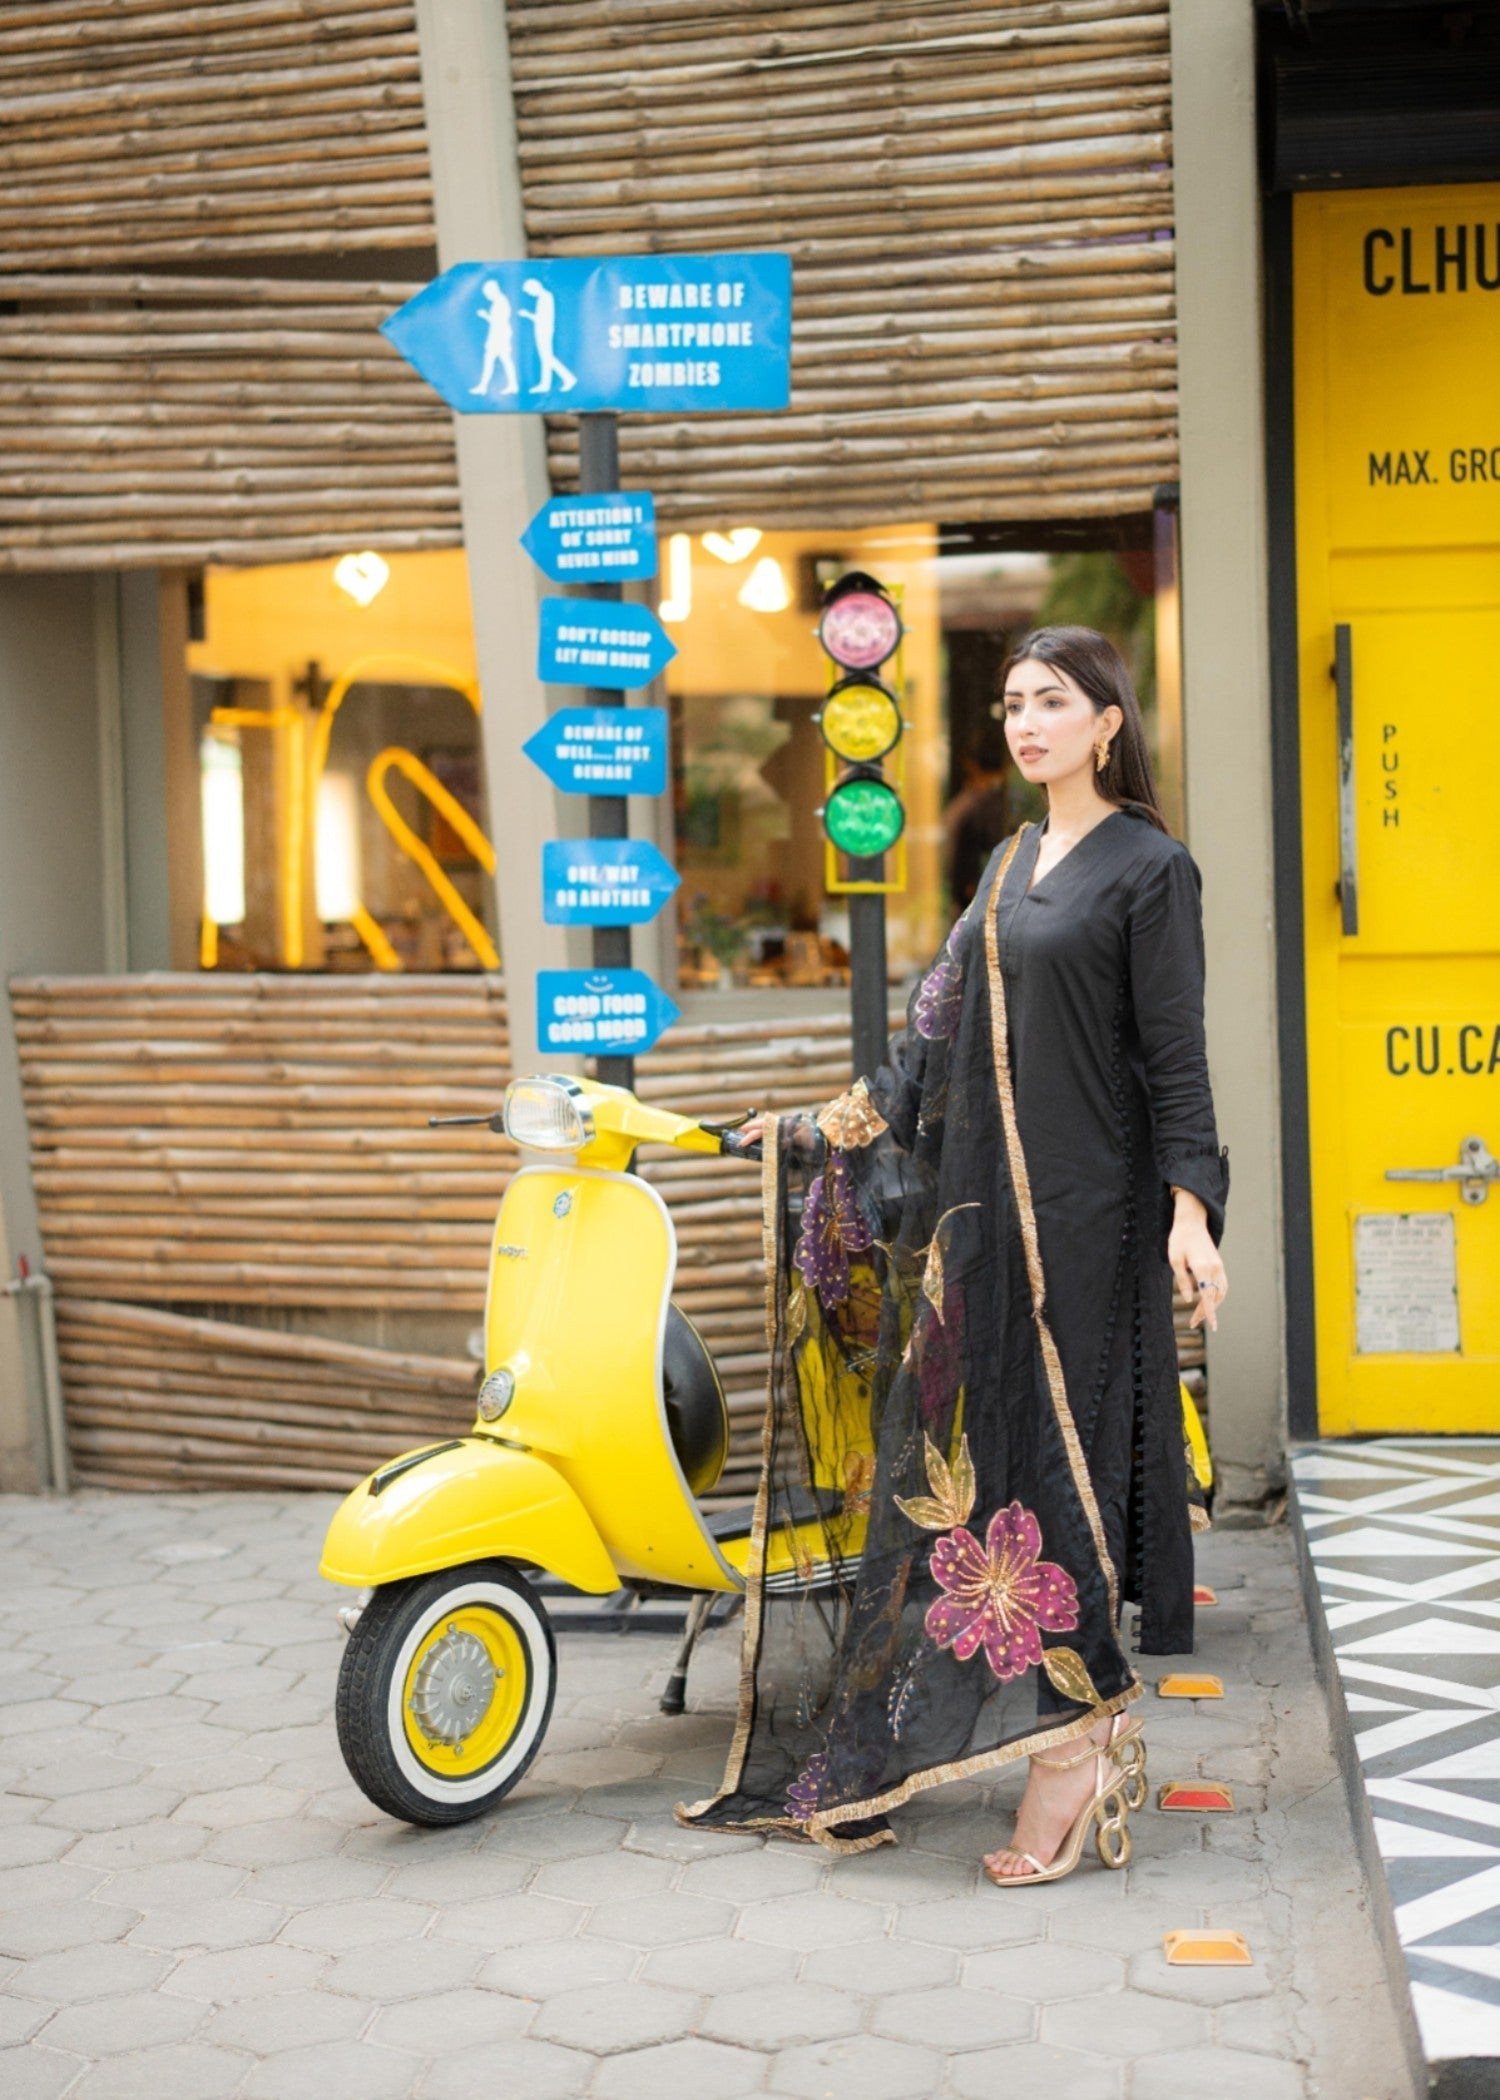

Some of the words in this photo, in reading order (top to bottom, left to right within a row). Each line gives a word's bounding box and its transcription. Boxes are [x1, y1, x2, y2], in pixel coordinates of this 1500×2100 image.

[1364, 224, 1500, 295] CLHU
[619, 284, 712, 309] BEWARE
[717, 283, 745, 308] OF
[609, 323, 752, 348] SMARTPHONE
[628, 360, 720, 387] ZOMBIES
[1369, 451, 1438, 486] MAX.
[549, 507, 633, 528] ATTENTION
[585, 528, 632, 546] SORRY
[556, 552, 600, 569] NEVER
[601, 549, 639, 566] MIND
[557, 625, 599, 644] DON'T
[600, 628, 652, 647] GOSSIP
[555, 647, 579, 662] LET
[579, 649, 608, 665] HIM
[609, 651, 650, 668] DRIVE
[564, 725, 622, 741] BEWARE
[625, 727, 643, 741] OF
[614, 746, 650, 761] JUST
[573, 764, 632, 780] BEWARE
[1382, 725, 1399, 828] PUSH
[567, 865, 598, 883] ONE
[605, 866, 639, 883] WAY
[556, 889, 577, 907] OR
[580, 889, 650, 907] ANOTHER
[553, 995, 600, 1017] GOOD
[603, 993, 646, 1015] FOOD
[548, 1021, 595, 1043] GOOD
[597, 1018, 647, 1040] MOOD
